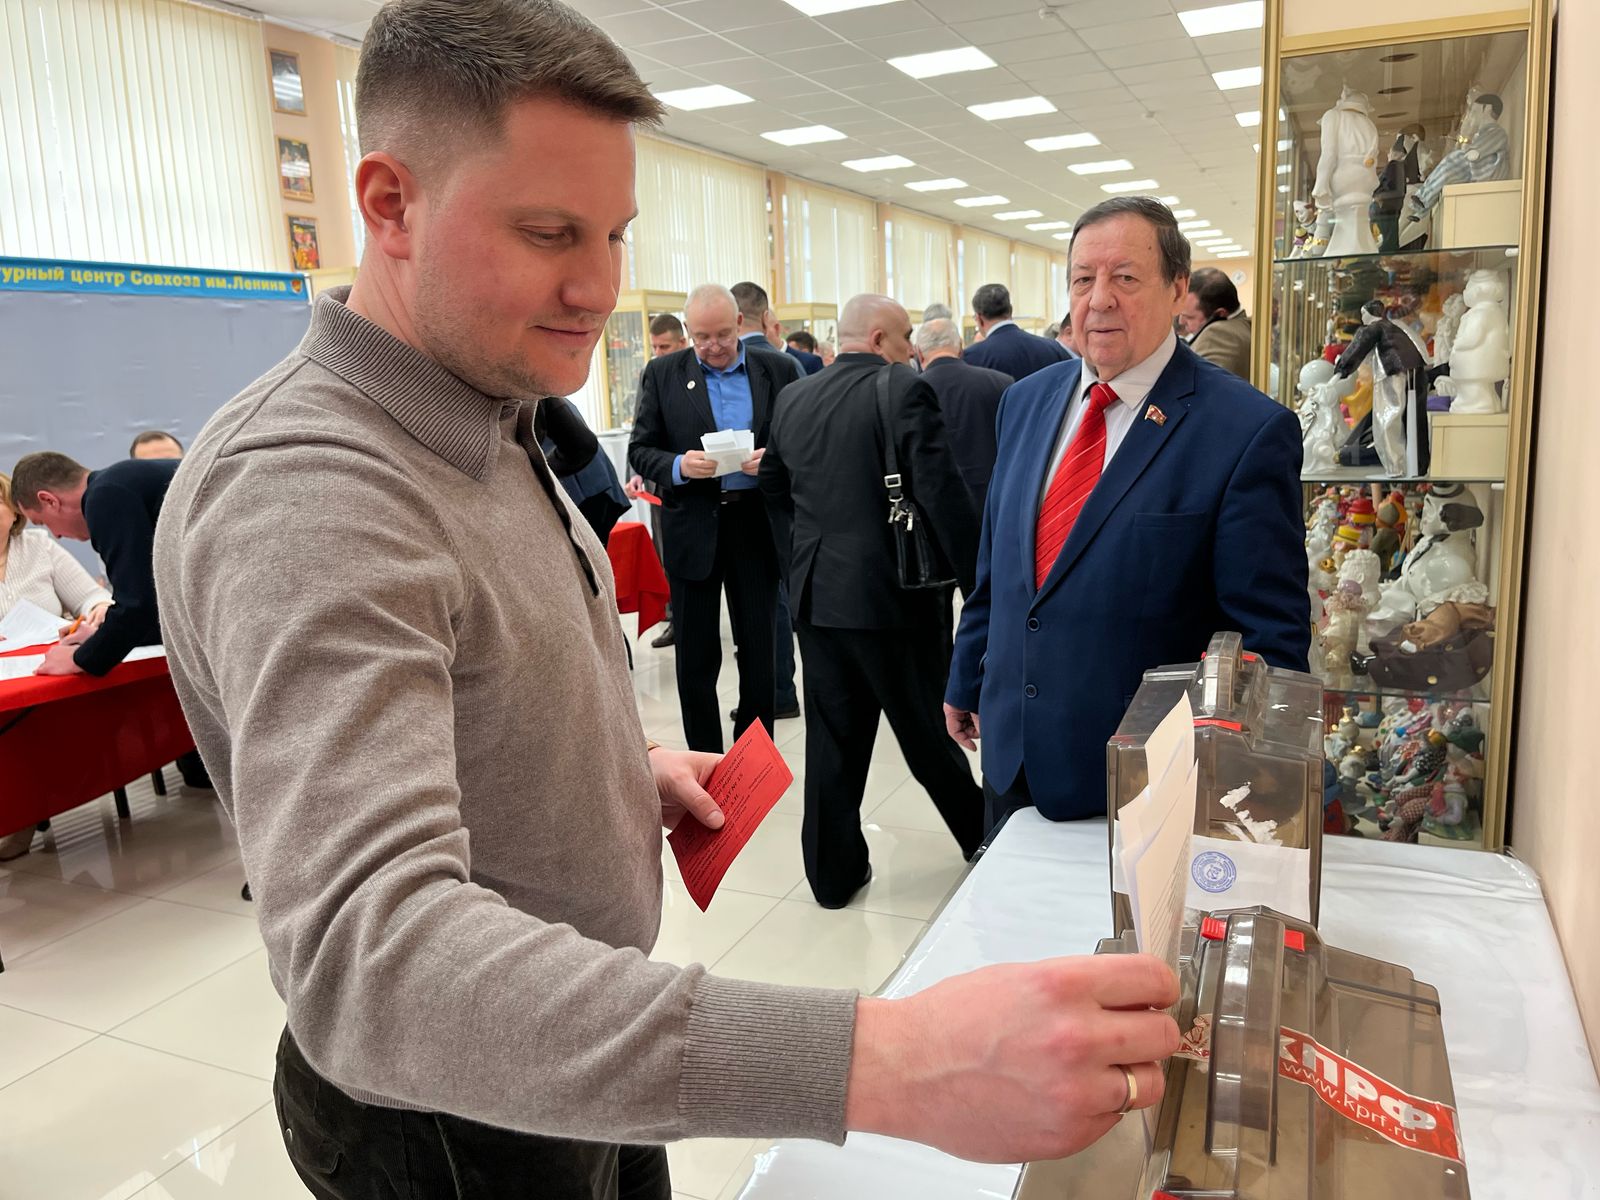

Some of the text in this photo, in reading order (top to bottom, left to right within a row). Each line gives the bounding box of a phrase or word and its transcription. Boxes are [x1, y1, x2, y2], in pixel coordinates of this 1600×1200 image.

[0, 266, 287, 291] урный центр Совхоза им.Ленина
[1283, 1060, 1417, 1143] www.kprf.ru
